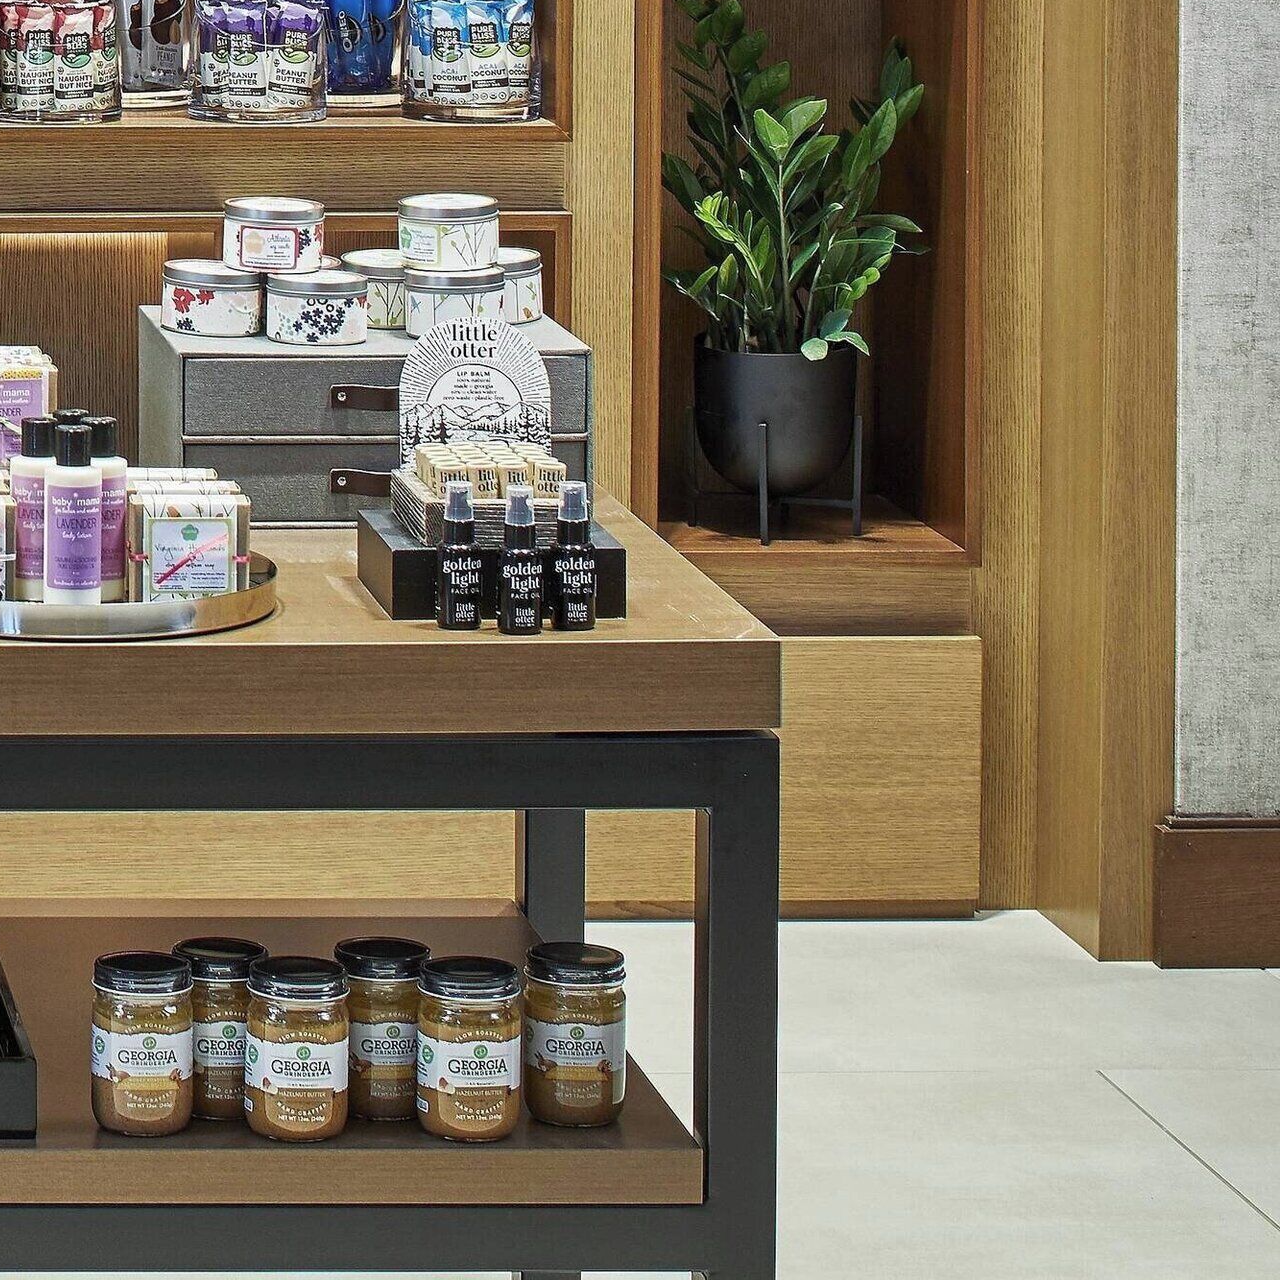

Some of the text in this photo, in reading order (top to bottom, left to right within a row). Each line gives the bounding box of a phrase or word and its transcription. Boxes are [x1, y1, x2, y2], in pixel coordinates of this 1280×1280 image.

[276, 68, 307, 78] PEANUT
[276, 75, 307, 84] BUTTER
[433, 74, 468, 82] COCONUT
[76, 81, 93, 89] NICE
[452, 323, 498, 341] little
[450, 342, 498, 359] otter
[2, 388, 30, 397] mama
[52, 496, 72, 510] baby
[57, 517, 97, 530] LAVENDER
[442, 557, 482, 573] golden
[502, 563, 543, 578] golden
[555, 557, 595, 573] golden
[451, 571, 480, 588] light
[510, 576, 540, 593] light
[563, 571, 593, 588] light
[455, 602, 475, 611] little
[515, 607, 535, 617] little
[278, 1031, 328, 1043] SLOW ROASTED
[475, 1030, 503, 1042] ROASTED
[546, 1038, 606, 1054] GEORGIA
[118, 1050, 178, 1065] GEORGIA
[271, 1060, 332, 1075] GEORGIA
[448, 1058, 508, 1074] GEORGIA
[276, 1102, 328, 1117] HAND CRAFTED
